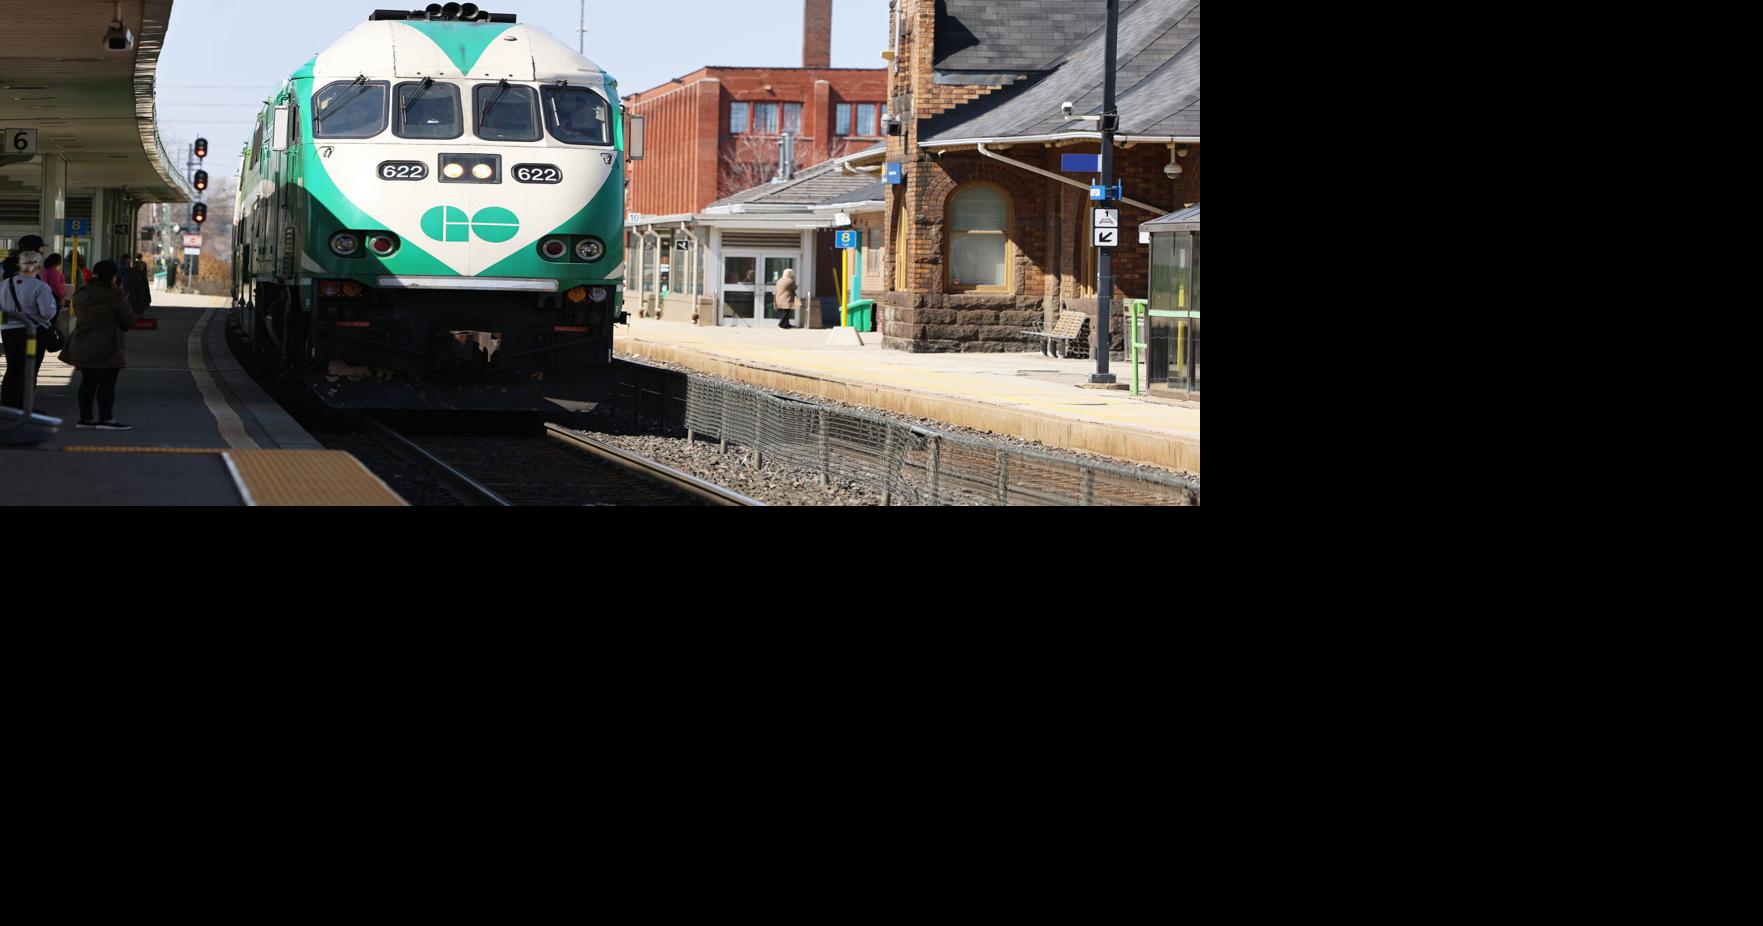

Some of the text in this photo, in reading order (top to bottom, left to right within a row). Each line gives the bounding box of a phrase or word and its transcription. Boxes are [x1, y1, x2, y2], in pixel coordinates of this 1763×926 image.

[14, 131, 28, 150] 6
[383, 165, 423, 178] 622
[518, 168, 558, 181] 622
[630, 214, 640, 222] 10
[1104, 210, 1109, 218] 1
[72, 220, 80, 230] 8
[420, 205, 520, 243] GO
[841, 232, 850, 243] 8
